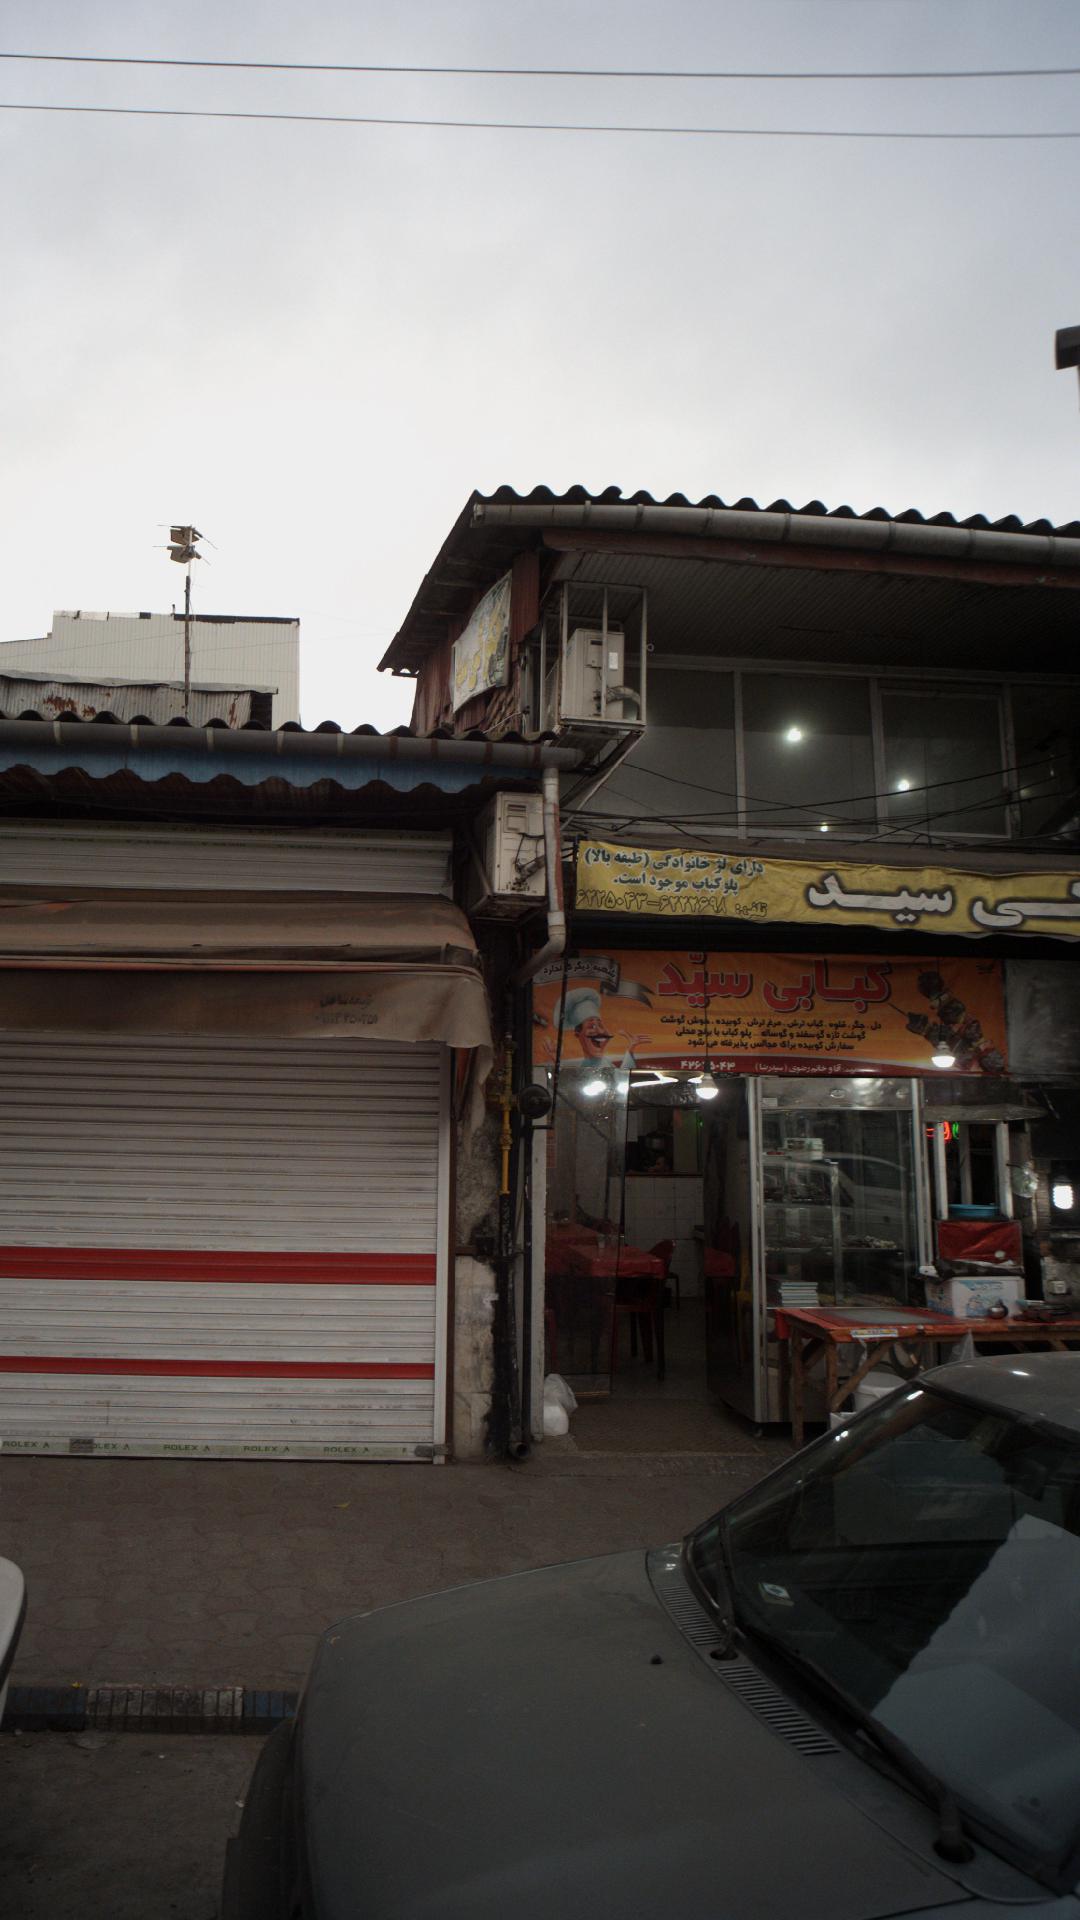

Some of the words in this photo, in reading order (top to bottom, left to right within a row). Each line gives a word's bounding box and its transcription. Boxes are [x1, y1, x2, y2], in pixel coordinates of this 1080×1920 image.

[652, 855, 710, 872] خانوادگی
[730, 861, 764, 876] دارای
[649, 876, 689, 893] موجود
[806, 873, 955, 926] سید
[763, 958, 890, 1013] کبابی
[747, 1017, 765, 1027] ترش
[787, 1019, 805, 1028] ترش
[807, 1019, 824, 1027] کباب
[851, 1019, 866, 1030] جگر
[714, 1027, 720, 1036] با
[796, 1029, 825, 1039] گوسفند
[826, 1030, 840, 1040] تازه
[841, 1030, 866, 1041] گوشت
[720, 1039, 748, 1049] پذیرفته
[750, 1039, 778, 1049] مجالس
[779, 1040, 796, 1050] برای
[798, 1040, 824, 1050] کوبیده
[825, 1041, 855, 1052] سفارش
[2, 1440, 37, 1449] ROLEX
[91, 1442, 118, 1450] OLEX
[163, 1444, 198, 1452] ROLEX
[243, 1445, 278, 1453] ROLEX
